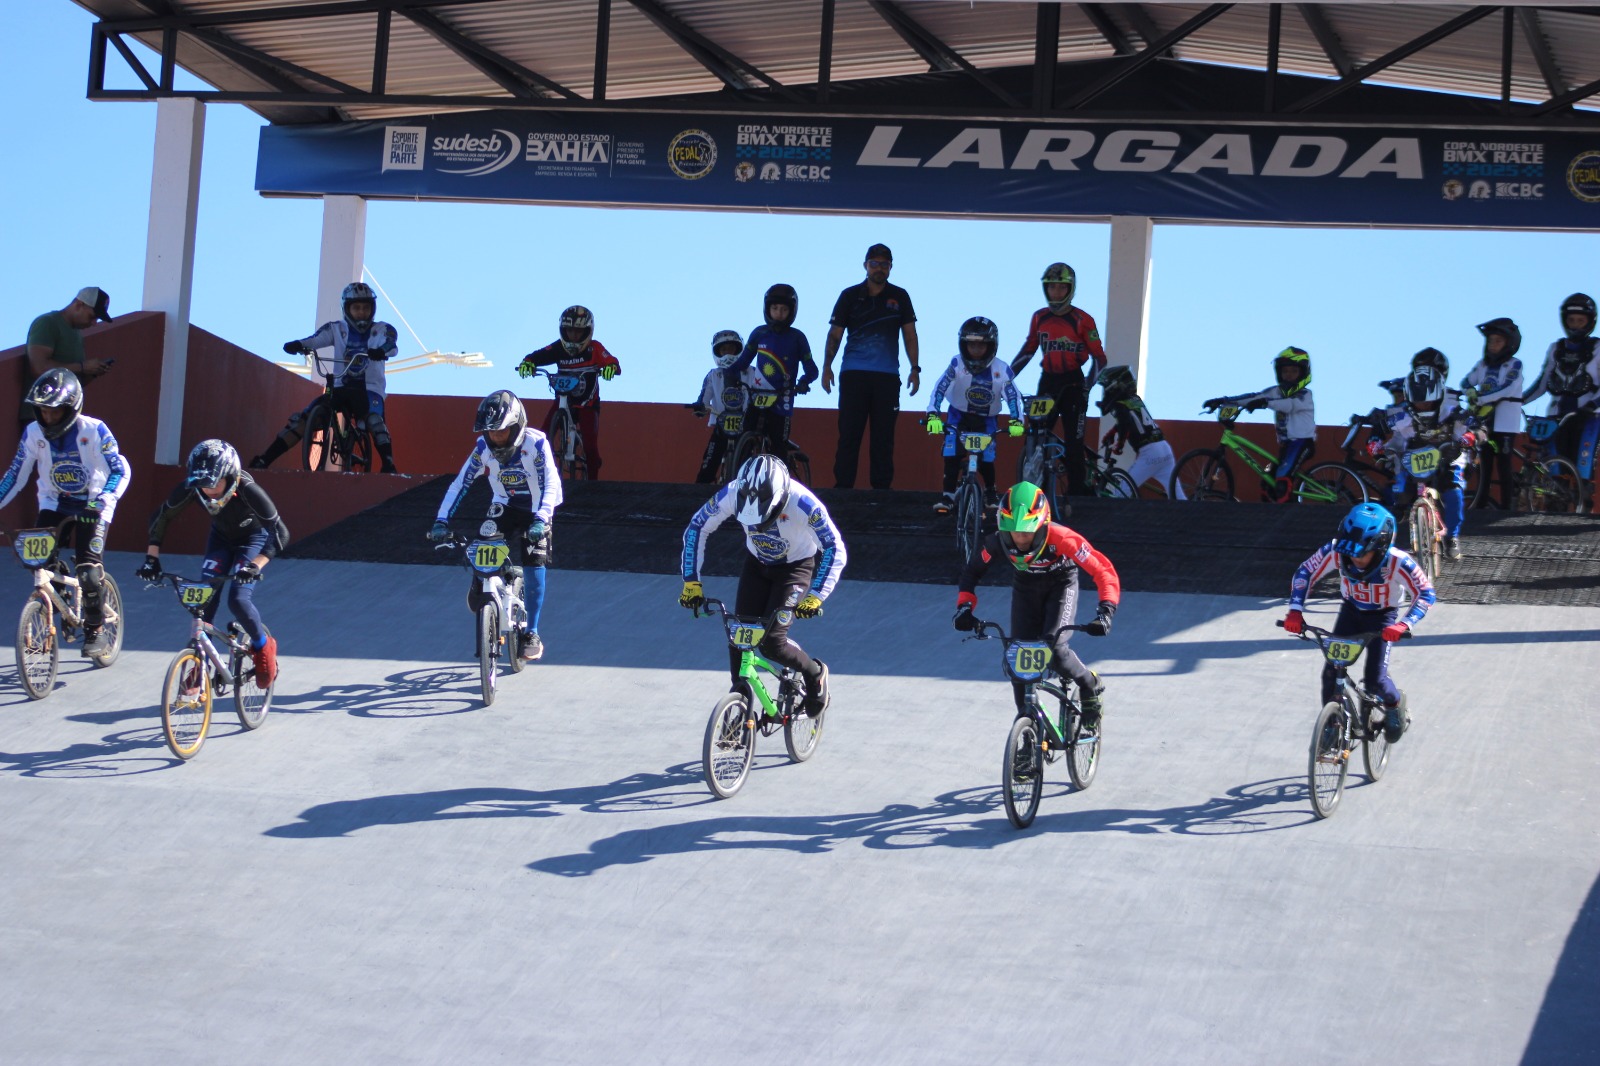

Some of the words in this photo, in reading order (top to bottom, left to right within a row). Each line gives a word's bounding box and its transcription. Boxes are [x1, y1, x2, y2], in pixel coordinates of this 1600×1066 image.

[737, 124, 768, 134] COPA
[772, 125, 832, 135] NORDESTE
[392, 131, 419, 144] ESPORTE
[432, 133, 502, 152] sudesb
[528, 132, 566, 141] GOVERNO
[567, 133, 579, 141] DO
[580, 134, 610, 142] ESTADO
[736, 133, 778, 146] BMX
[784, 134, 832, 147] RACE
[525, 140, 610, 163] BAHIA
[675, 145, 700, 161] PEDAL
[758, 146, 808, 159] 2025
[856, 126, 1423, 180] LARGADA
[1443, 141, 1476, 150] COPA
[1480, 142, 1544, 152] NORDESTE
[390, 152, 417, 164] PARTE
[1443, 150, 1487, 163] BMX
[1493, 151, 1544, 164] RACE
[797, 165, 831, 180] CBC
[1466, 163, 1519, 177] 2025
[1507, 182, 1544, 197] CBC
[756, 395, 769, 405] 87
[1032, 401, 1047, 415] 74
[725, 416, 741, 431] 115
[968, 437, 981, 448] 18
[1413, 452, 1435, 471] 122
[54, 471, 78, 483] PEDAL
[26, 538, 48, 557] 128
[1337, 539, 1364, 553] FLY
[477, 547, 498, 566] 114
[187, 588, 204, 602] 93
[738, 629, 753, 644] 13
[1332, 643, 1350, 659] 83
[1019, 649, 1045, 670] 69
